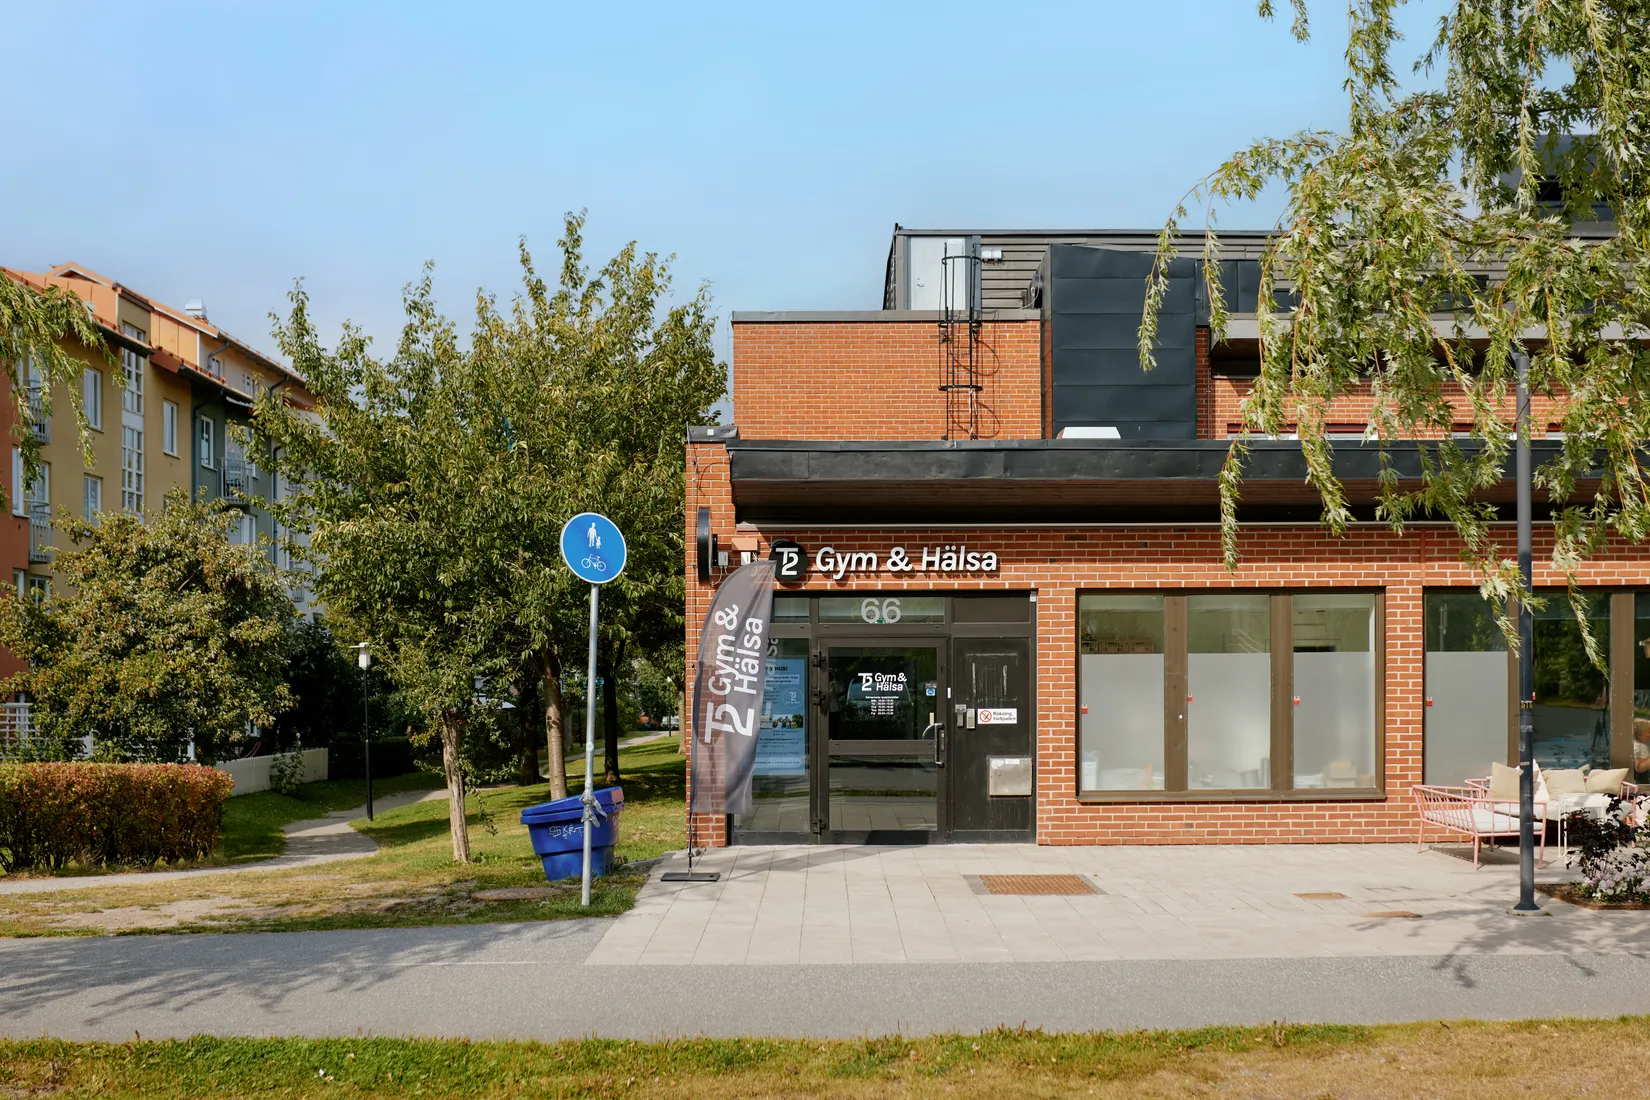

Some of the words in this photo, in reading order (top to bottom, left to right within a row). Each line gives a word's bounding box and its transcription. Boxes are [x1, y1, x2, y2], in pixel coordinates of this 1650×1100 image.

[775, 547, 799, 576] T2
[815, 546, 878, 580] Gym
[886, 546, 913, 572] &
[921, 545, 998, 572] Hälsa
[714, 603, 739, 631] &
[860, 597, 901, 624] 66
[708, 634, 740, 696] Gym
[733, 617, 764, 695] Hälsa
[874, 672, 897, 683] Gym
[897, 672, 907, 682] &
[876, 681, 904, 691] Hälsa
